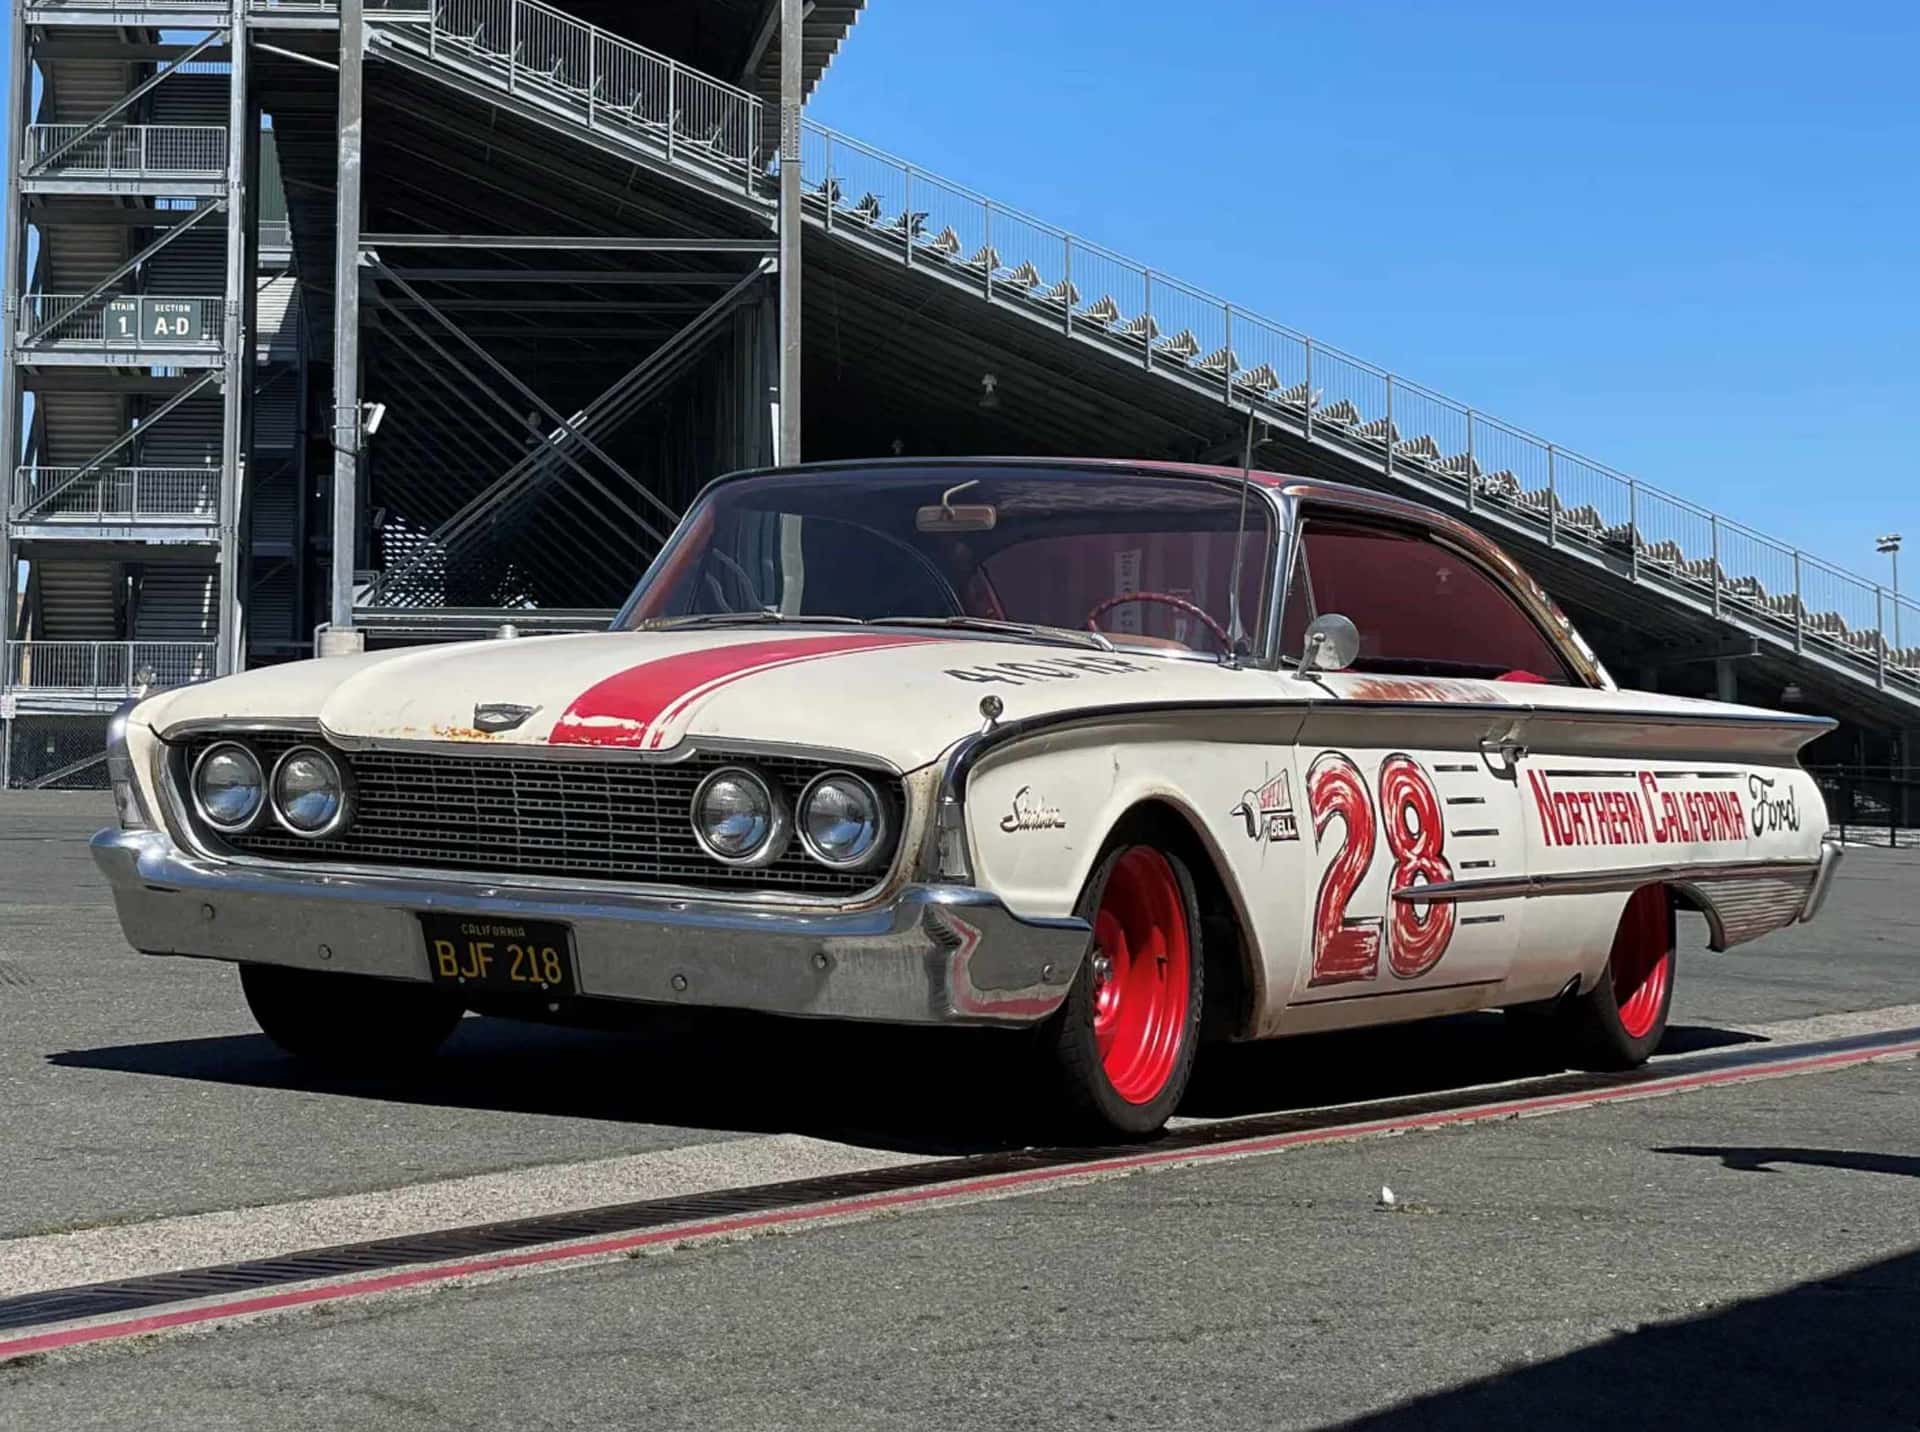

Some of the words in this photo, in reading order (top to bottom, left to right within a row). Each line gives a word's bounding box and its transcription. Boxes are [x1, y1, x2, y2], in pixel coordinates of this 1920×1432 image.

[111, 302, 136, 311] STAIR
[155, 304, 191, 312] SECTION
[118, 316, 128, 334] 1
[154, 317, 189, 336] A-D
[943, 661, 1081, 686] 410
[1527, 769, 1649, 847] NORTHERN
[1638, 770, 1749, 844] CALIFORNIA
[1748, 773, 1801, 837] Ford
[1305, 749, 1457, 988] 28
[461, 923, 526, 937] CALIFORNIA
[434, 940, 495, 978] BJF
[507, 943, 563, 984] 218
